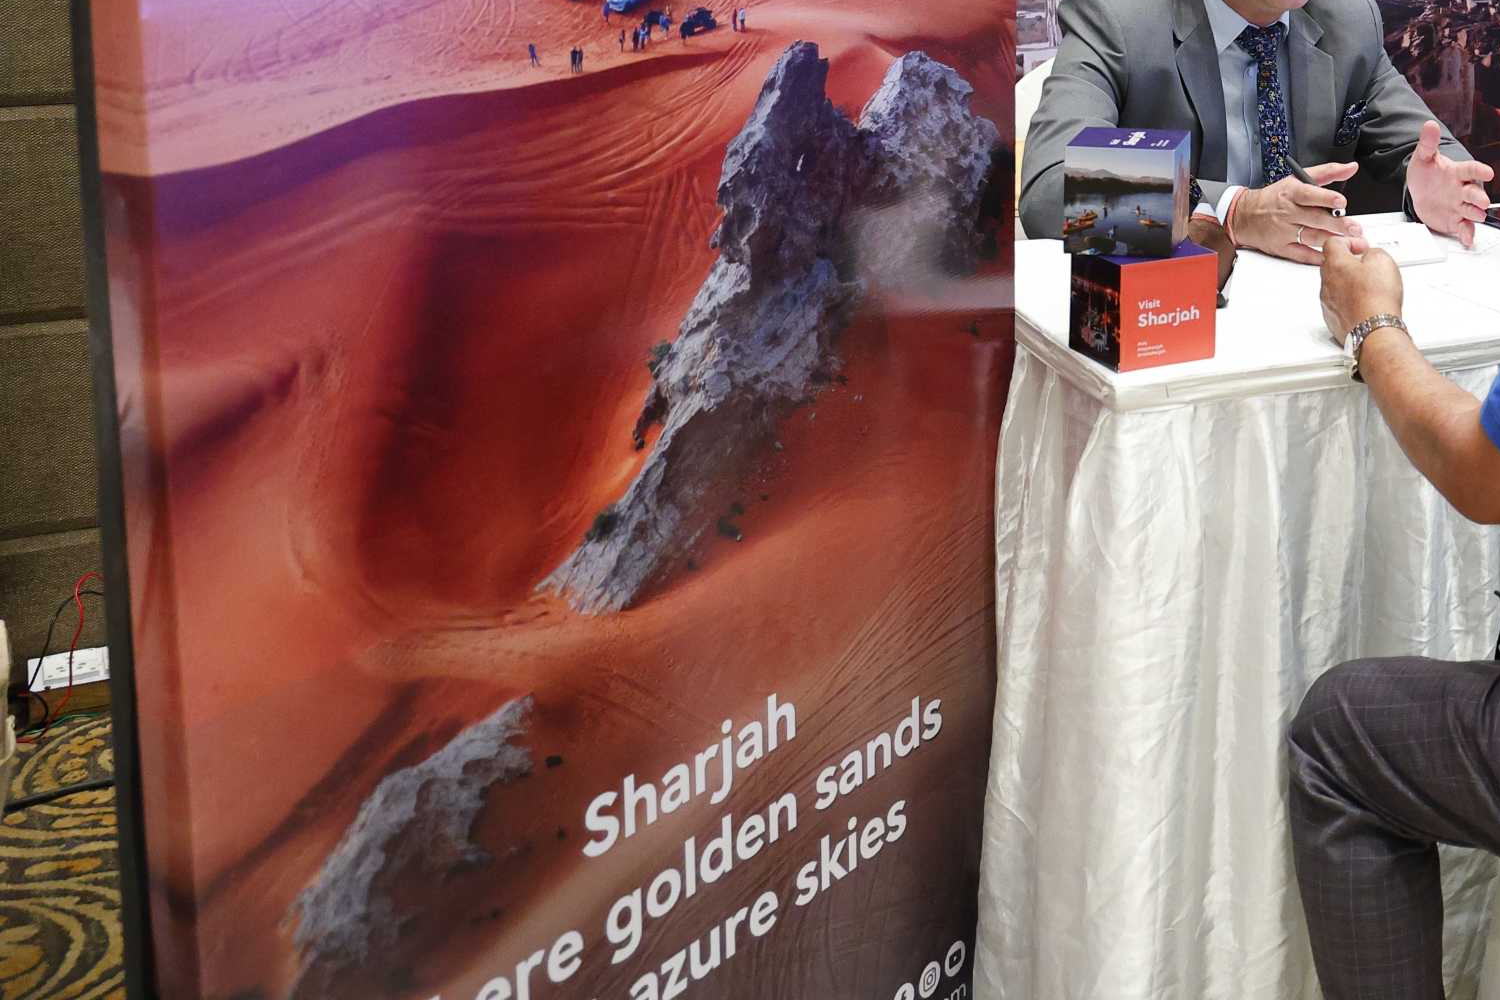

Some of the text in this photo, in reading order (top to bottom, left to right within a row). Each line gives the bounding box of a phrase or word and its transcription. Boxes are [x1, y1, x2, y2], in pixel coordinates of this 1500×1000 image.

[1138, 299, 1160, 310] Visit
[1138, 306, 1200, 327] Sharjah
[582, 693, 796, 857] Sharjah
[606, 792, 797, 964] golden
[814, 696, 942, 810] sands
[629, 800, 906, 1000] azure skies
